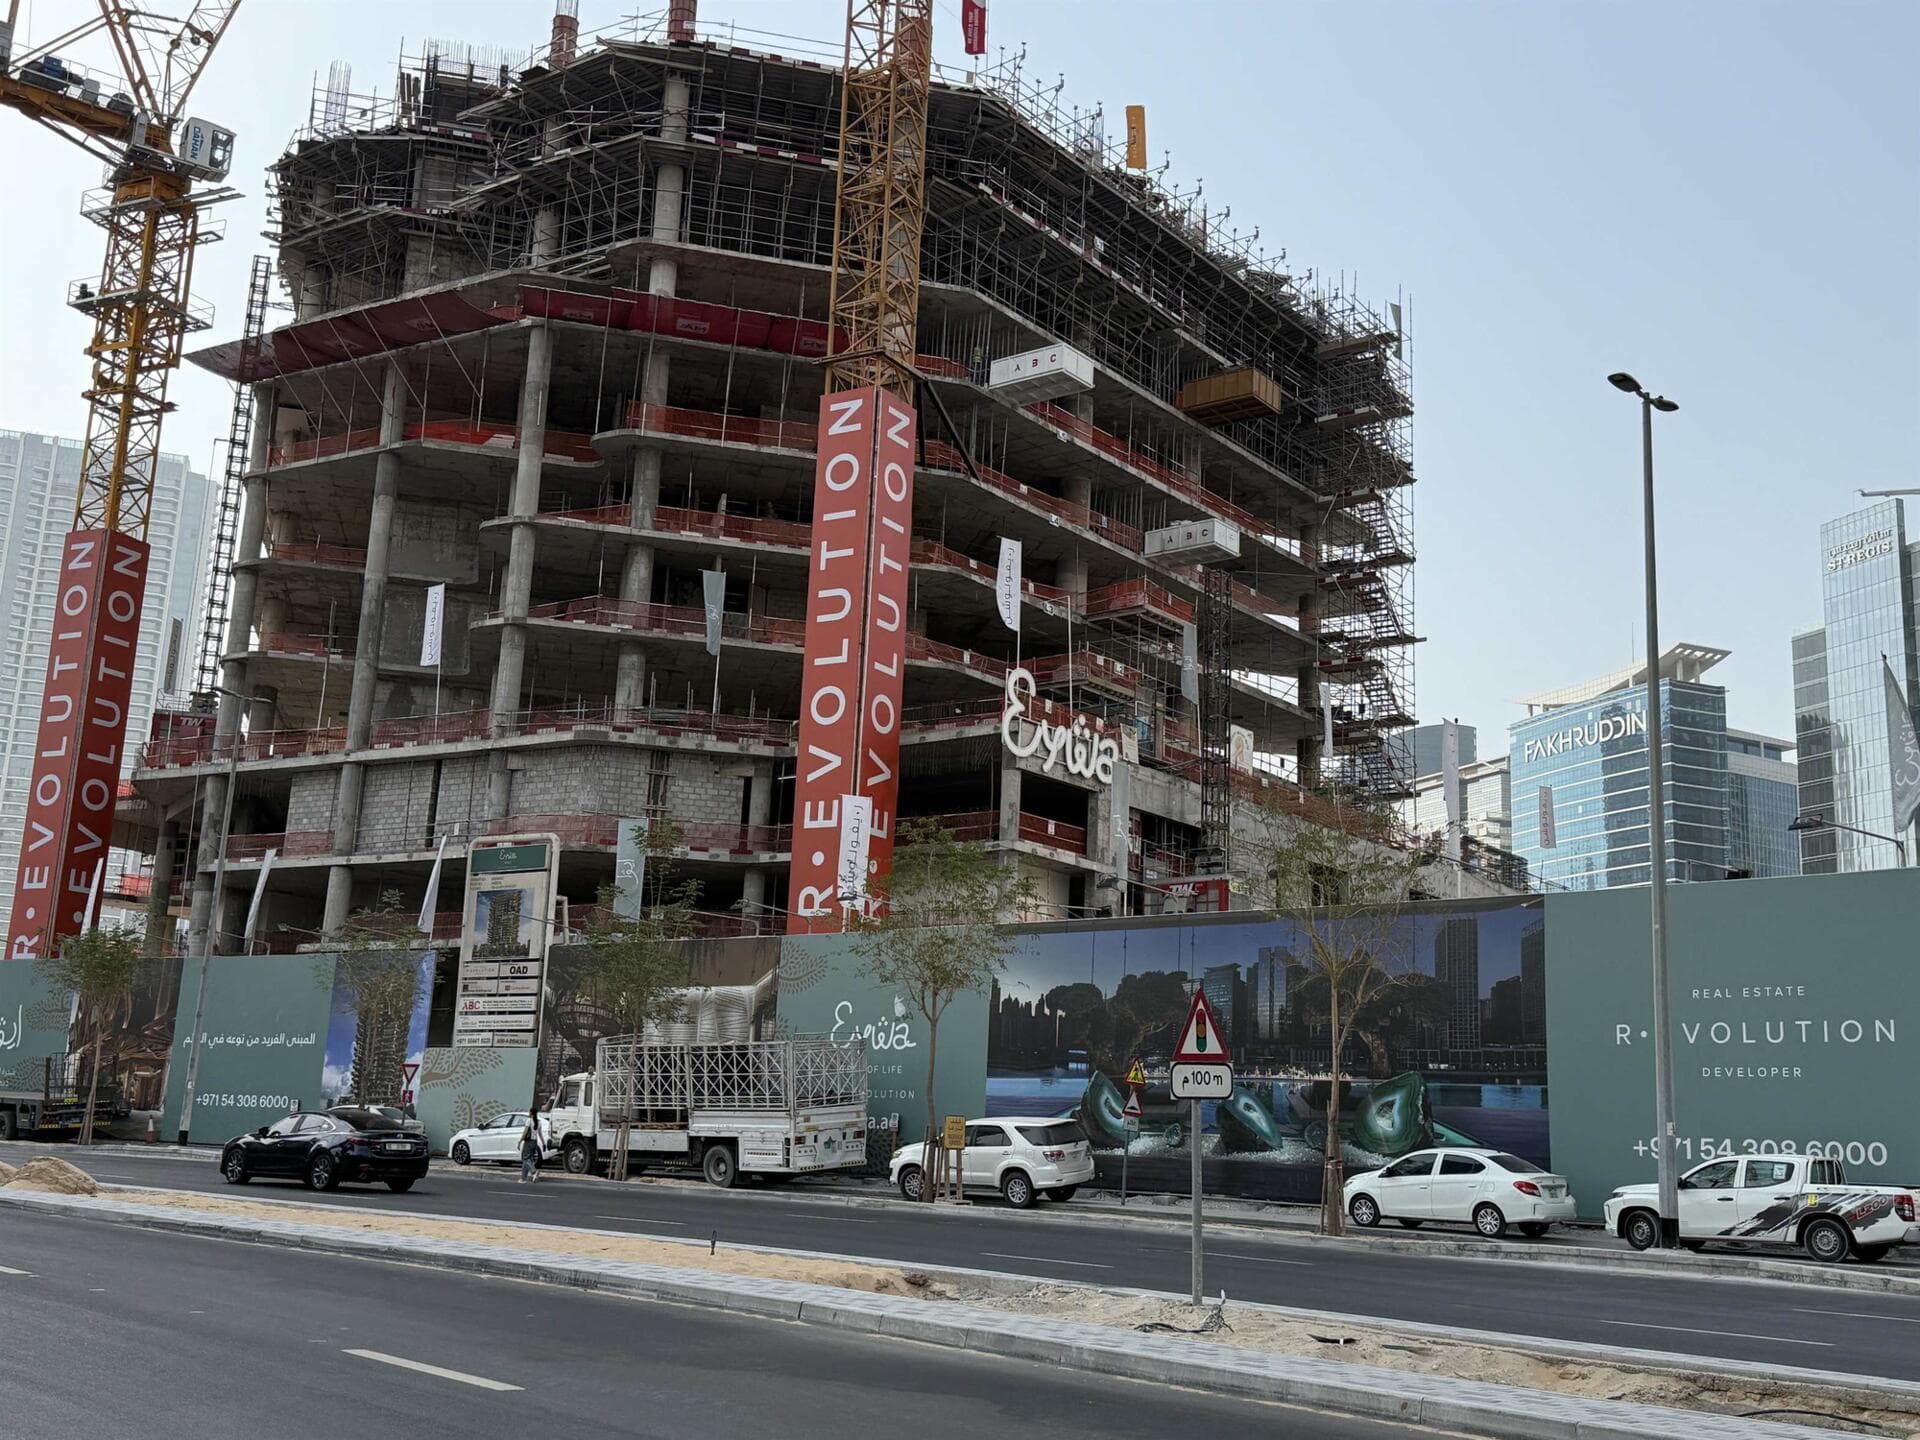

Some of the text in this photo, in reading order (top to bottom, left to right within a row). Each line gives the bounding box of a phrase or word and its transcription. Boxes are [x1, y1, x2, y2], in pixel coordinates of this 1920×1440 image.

[191, 126, 201, 160] DAHAN
[1524, 709, 1648, 763] FAKHRUDDIN
[1692, 985, 1806, 999] REAL ESTATE
[208, 1033, 225, 1049] في
[246, 1035, 260, 1047] من
[867, 1065, 879, 1074] OF
[882, 1065, 903, 1074] LIFE
[1702, 1066, 1802, 1078] DEVELOPER
[196, 1093, 289, 1109] +971 54 308 6000
